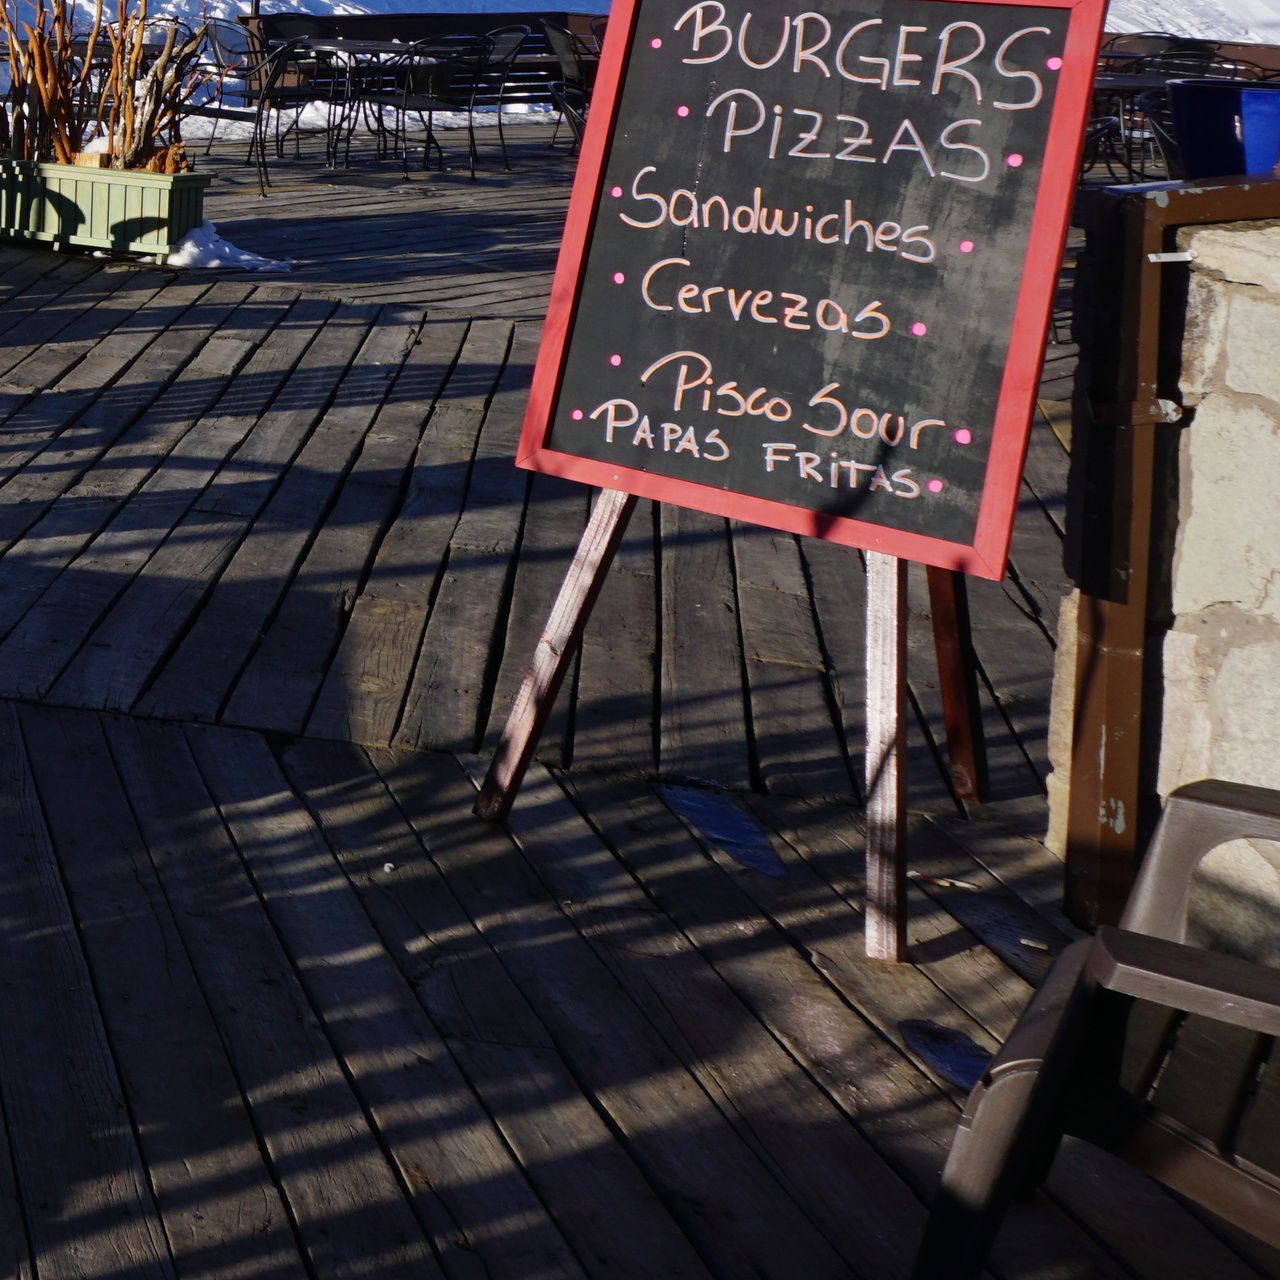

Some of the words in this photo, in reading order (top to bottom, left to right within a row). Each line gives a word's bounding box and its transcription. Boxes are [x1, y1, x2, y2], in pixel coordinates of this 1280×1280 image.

[674, 0, 1053, 111] BURGERS
[619, 166, 938, 264] Sandwiches
[641, 257, 892, 339] Cervezas
[589, 397, 731, 462] PAPAS
[640, 350, 793, 421] Pisco
[802, 381, 946, 450] Sour
